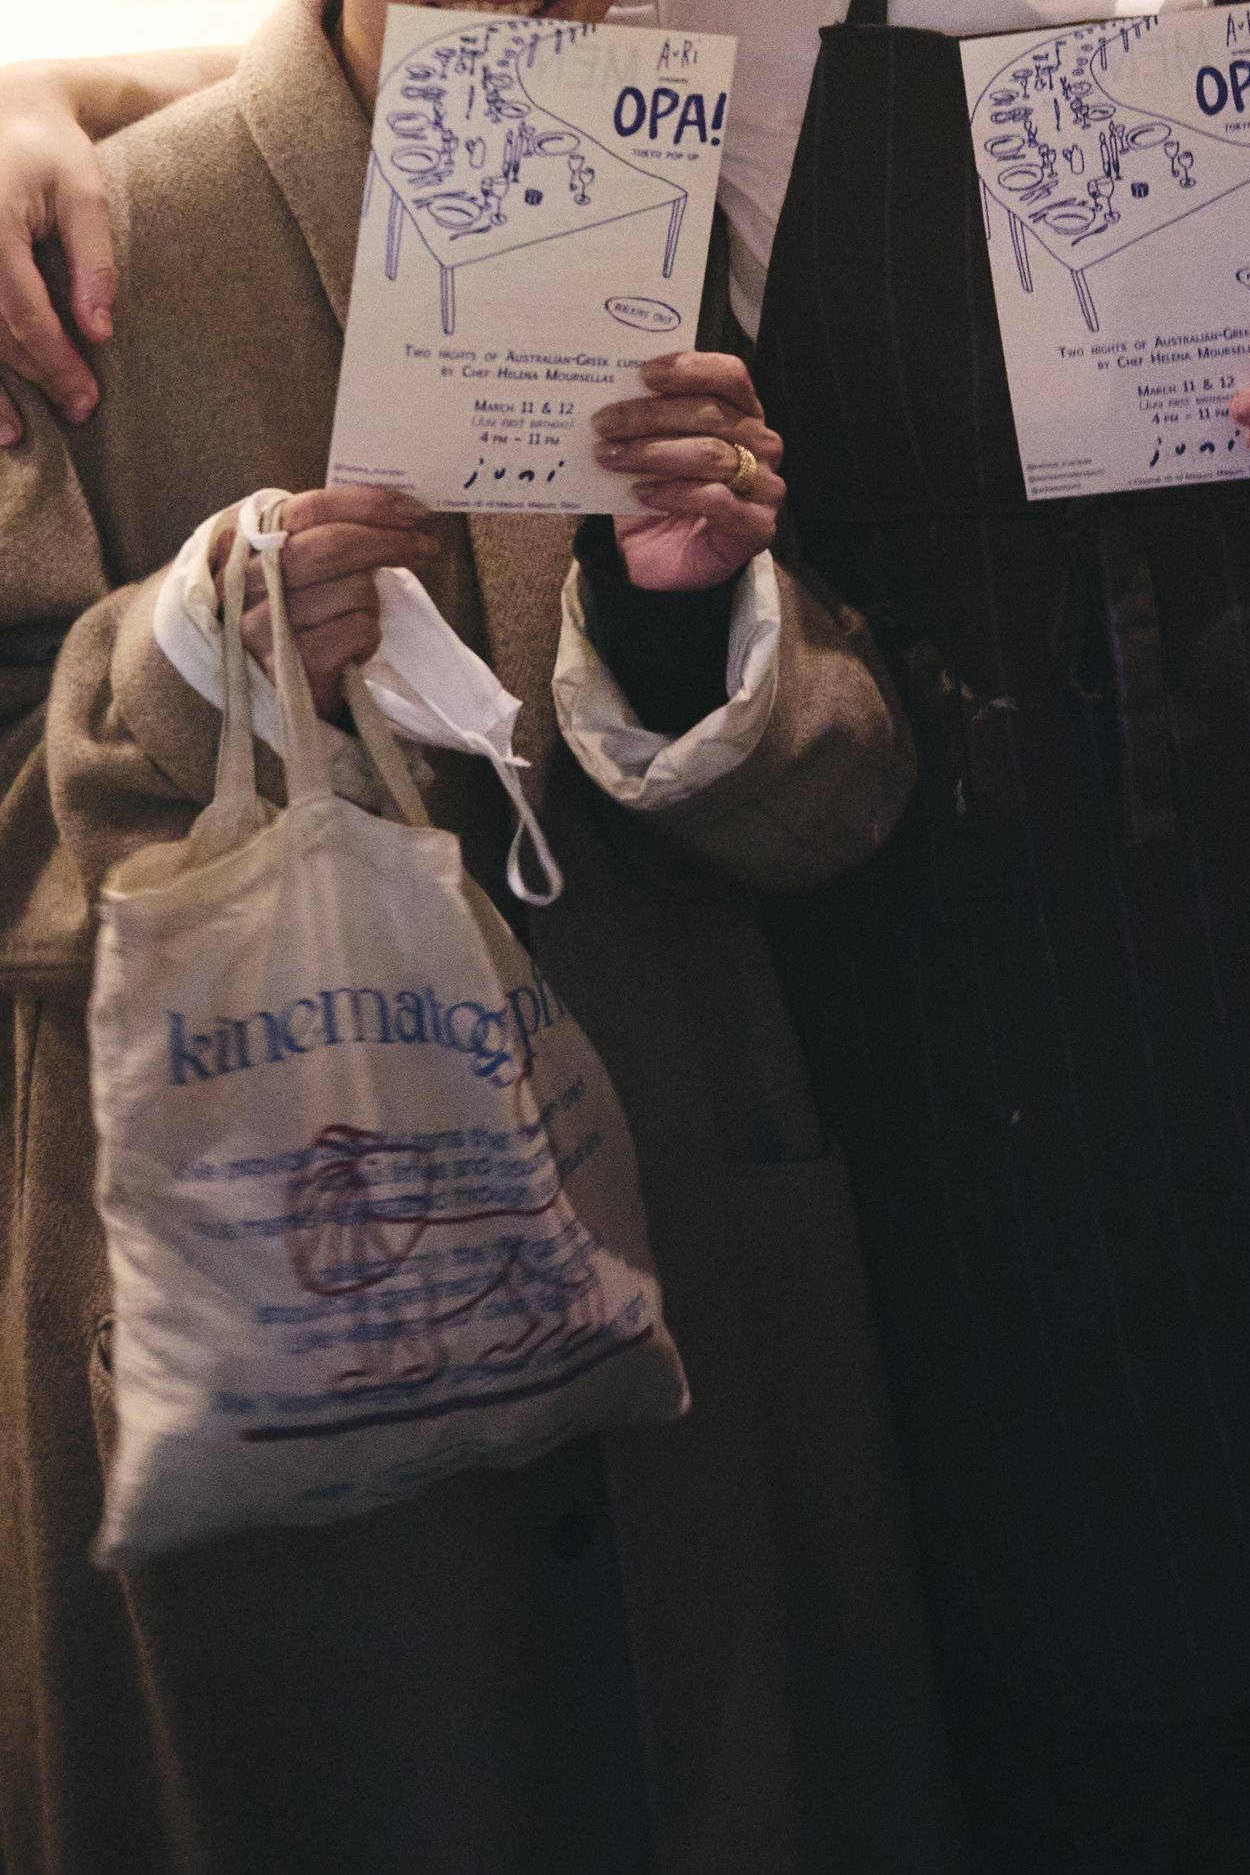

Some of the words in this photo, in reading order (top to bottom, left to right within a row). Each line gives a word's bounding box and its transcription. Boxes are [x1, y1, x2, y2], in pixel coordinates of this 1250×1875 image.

[613, 86, 727, 146] OPA!
[665, 151, 683, 159] POP
[687, 153, 699, 161] UP
[1183, 380, 1195, 393] 11
[1203, 378, 1213, 391] &
[1220, 375, 1235, 389] 12
[521, 401, 534, 414] 11
[541, 402, 552, 414] &
[559, 401, 574, 414] 12
[1152, 413, 1160, 425] 4
[1199, 408, 1210, 420] 11
[480, 432, 489, 443] 4
[527, 432, 541, 445] 11
[1150, 429, 1241, 468] juni
[463, 457, 565, 489] juni
